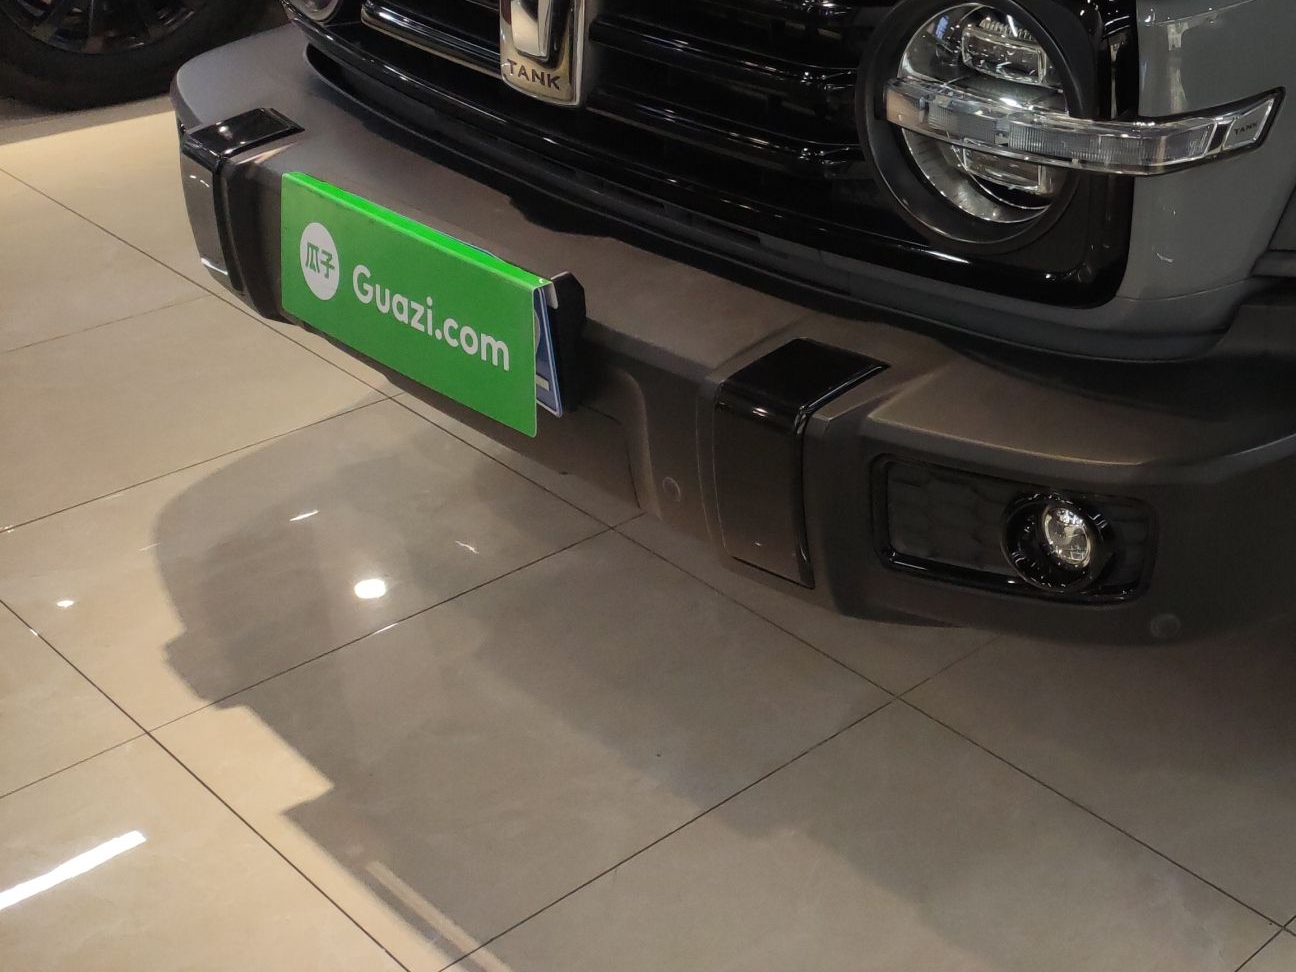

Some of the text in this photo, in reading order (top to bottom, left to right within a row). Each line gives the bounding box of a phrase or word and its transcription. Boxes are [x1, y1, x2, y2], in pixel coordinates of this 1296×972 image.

[506, 58, 561, 90] TANK
[1233, 123, 1257, 135] TANK
[304, 241, 336, 279] 瓜子
[352, 264, 511, 372] Guazi.com
